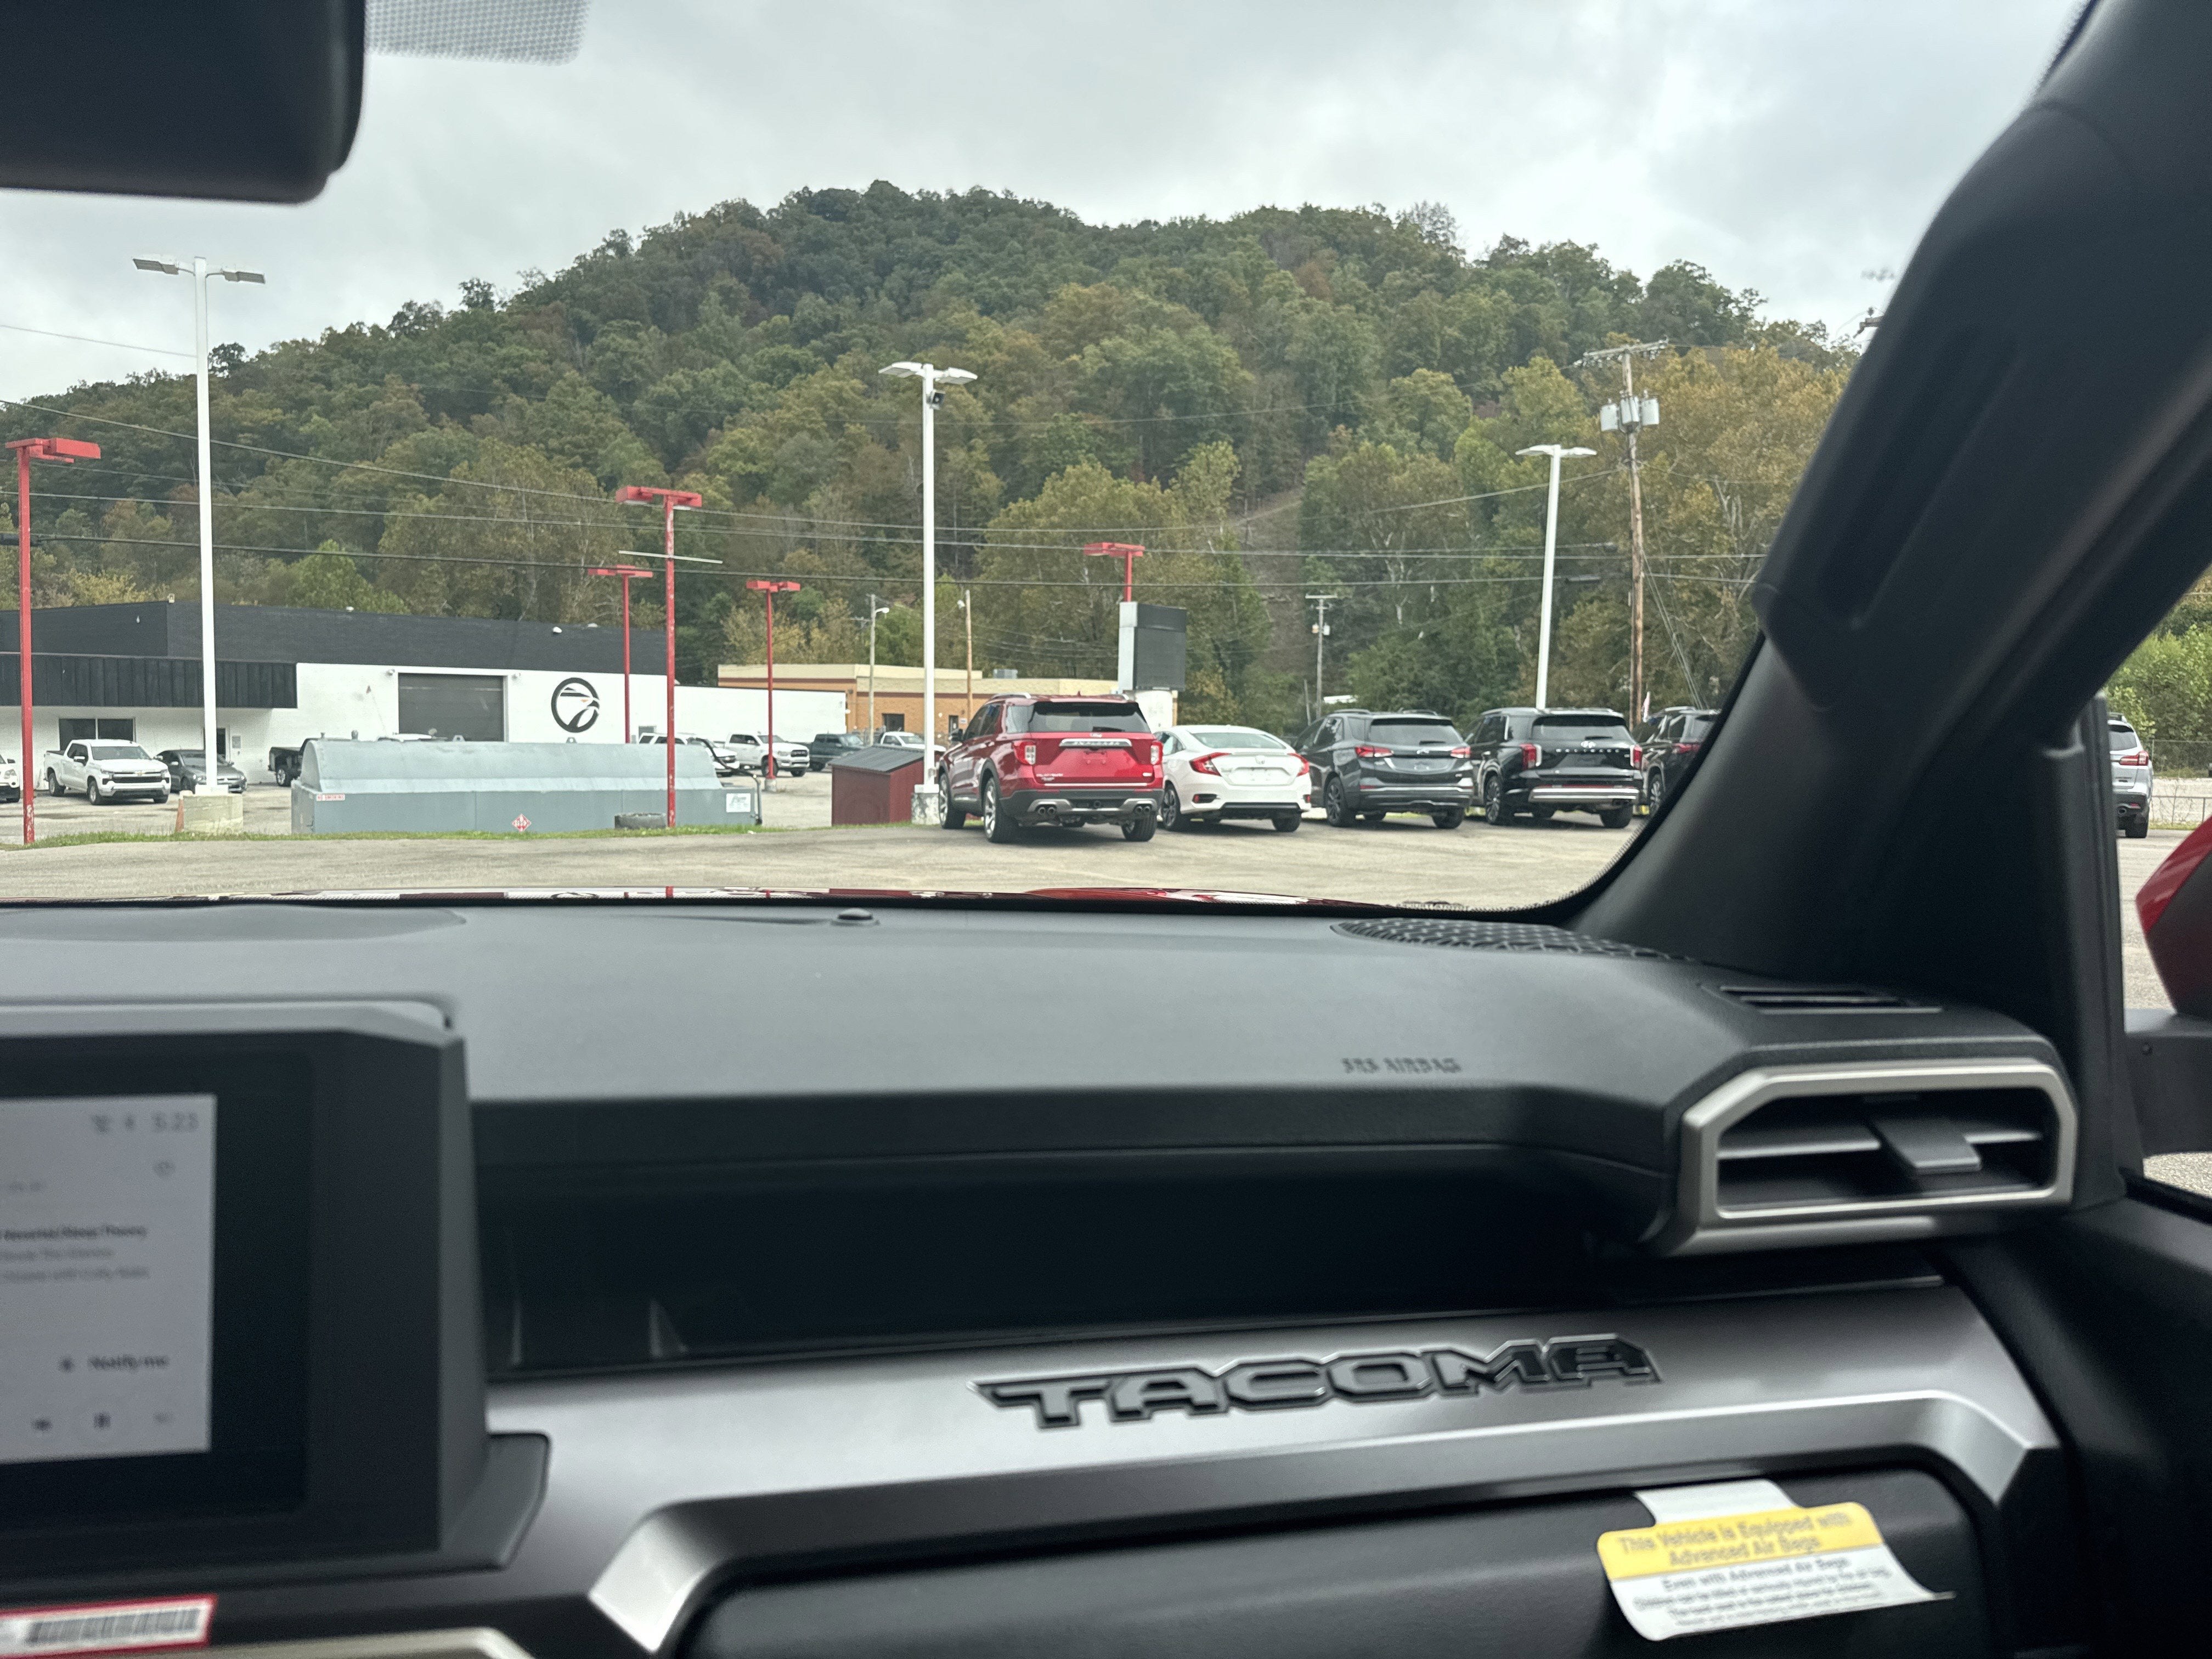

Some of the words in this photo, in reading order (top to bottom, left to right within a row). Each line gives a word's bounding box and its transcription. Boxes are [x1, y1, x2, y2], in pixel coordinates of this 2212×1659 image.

[1383, 1057, 1462, 1074] AIRBAG
[969, 1333, 1663, 1429] TACOMA
[1618, 1536, 1656, 1553] This
[1657, 1528, 1717, 1548] Vehicle
[1737, 1516, 1814, 1541] Equipped
[1816, 1511, 1852, 1529] with
[1669, 1543, 1751, 1567] Advanced
[1753, 1538, 1775, 1555] Air
